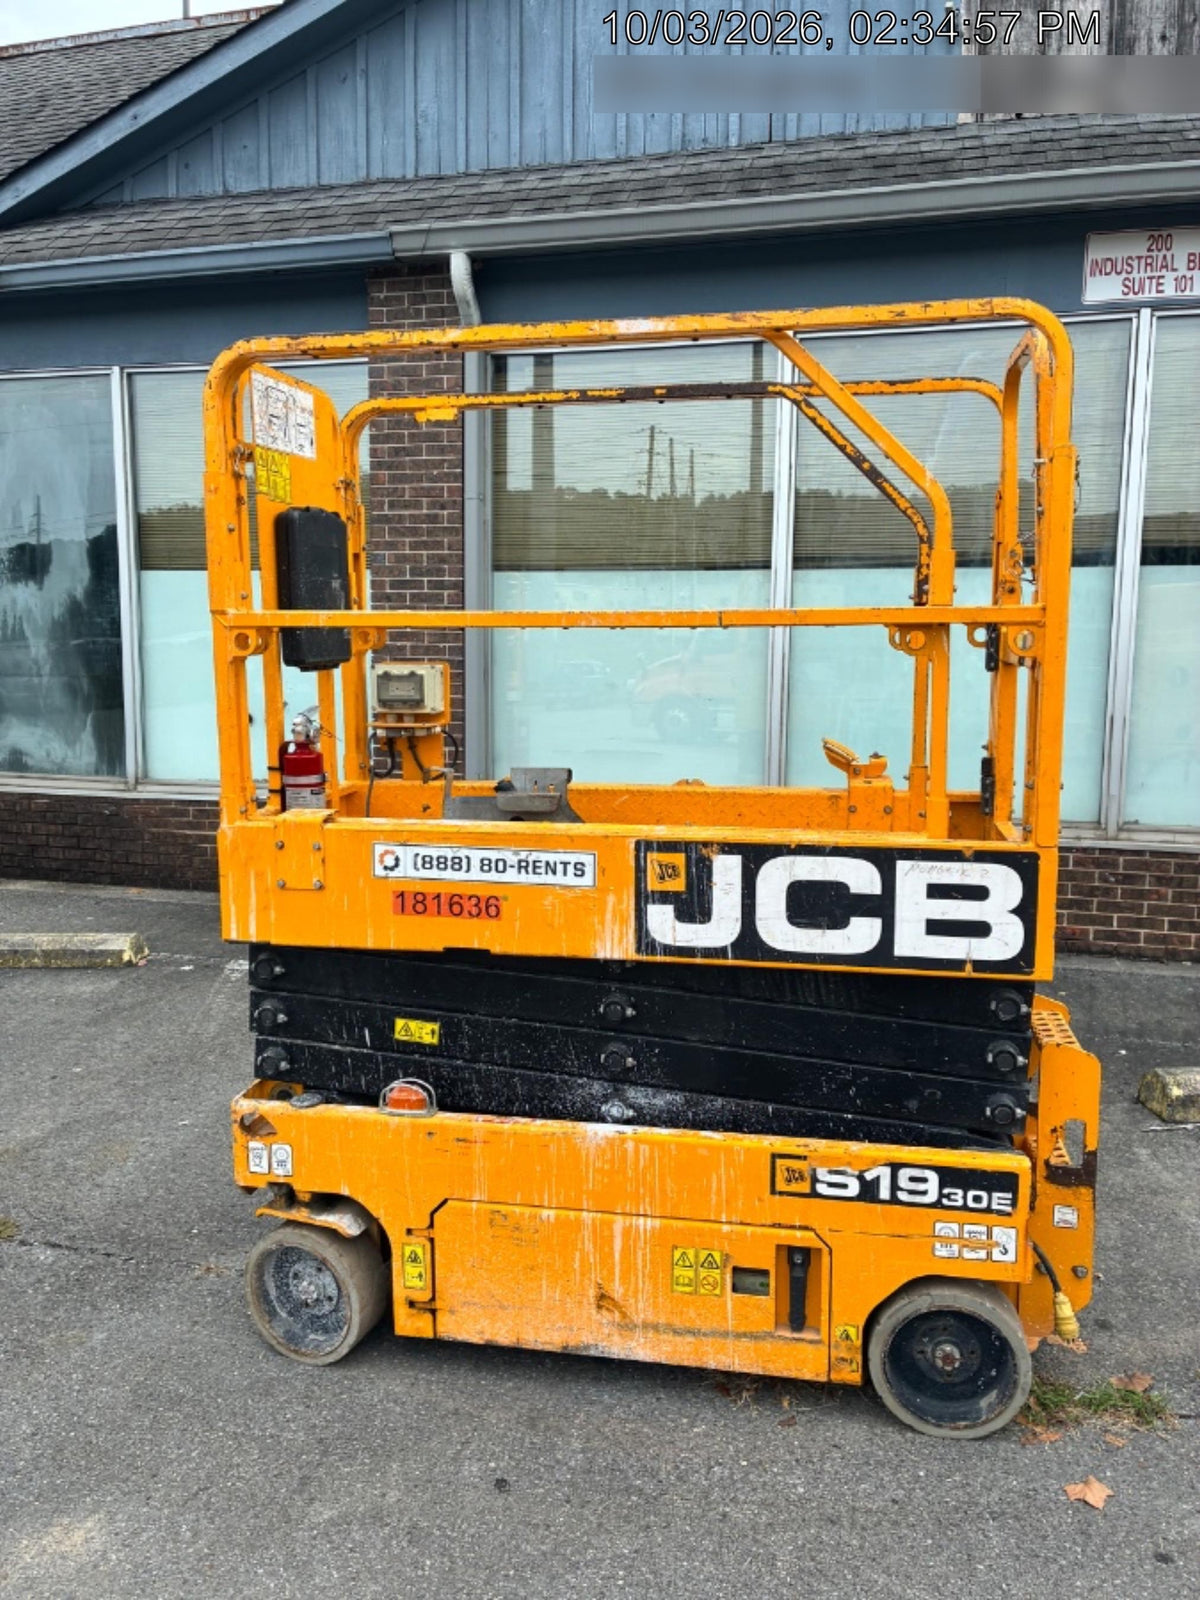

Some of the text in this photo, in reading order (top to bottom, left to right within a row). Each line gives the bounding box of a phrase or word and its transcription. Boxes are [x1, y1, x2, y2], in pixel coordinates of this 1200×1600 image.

[1146, 233, 1173, 253] 200
[1089, 253, 1178, 277] INDUSTRIAL
[1121, 274, 1194, 296] SUITE 101
[413, 853, 586, 877] (888) 80-RENTS
[656, 862, 682, 883] JCB
[395, 890, 501, 918] 181636
[646, 854, 1025, 961] JCB
